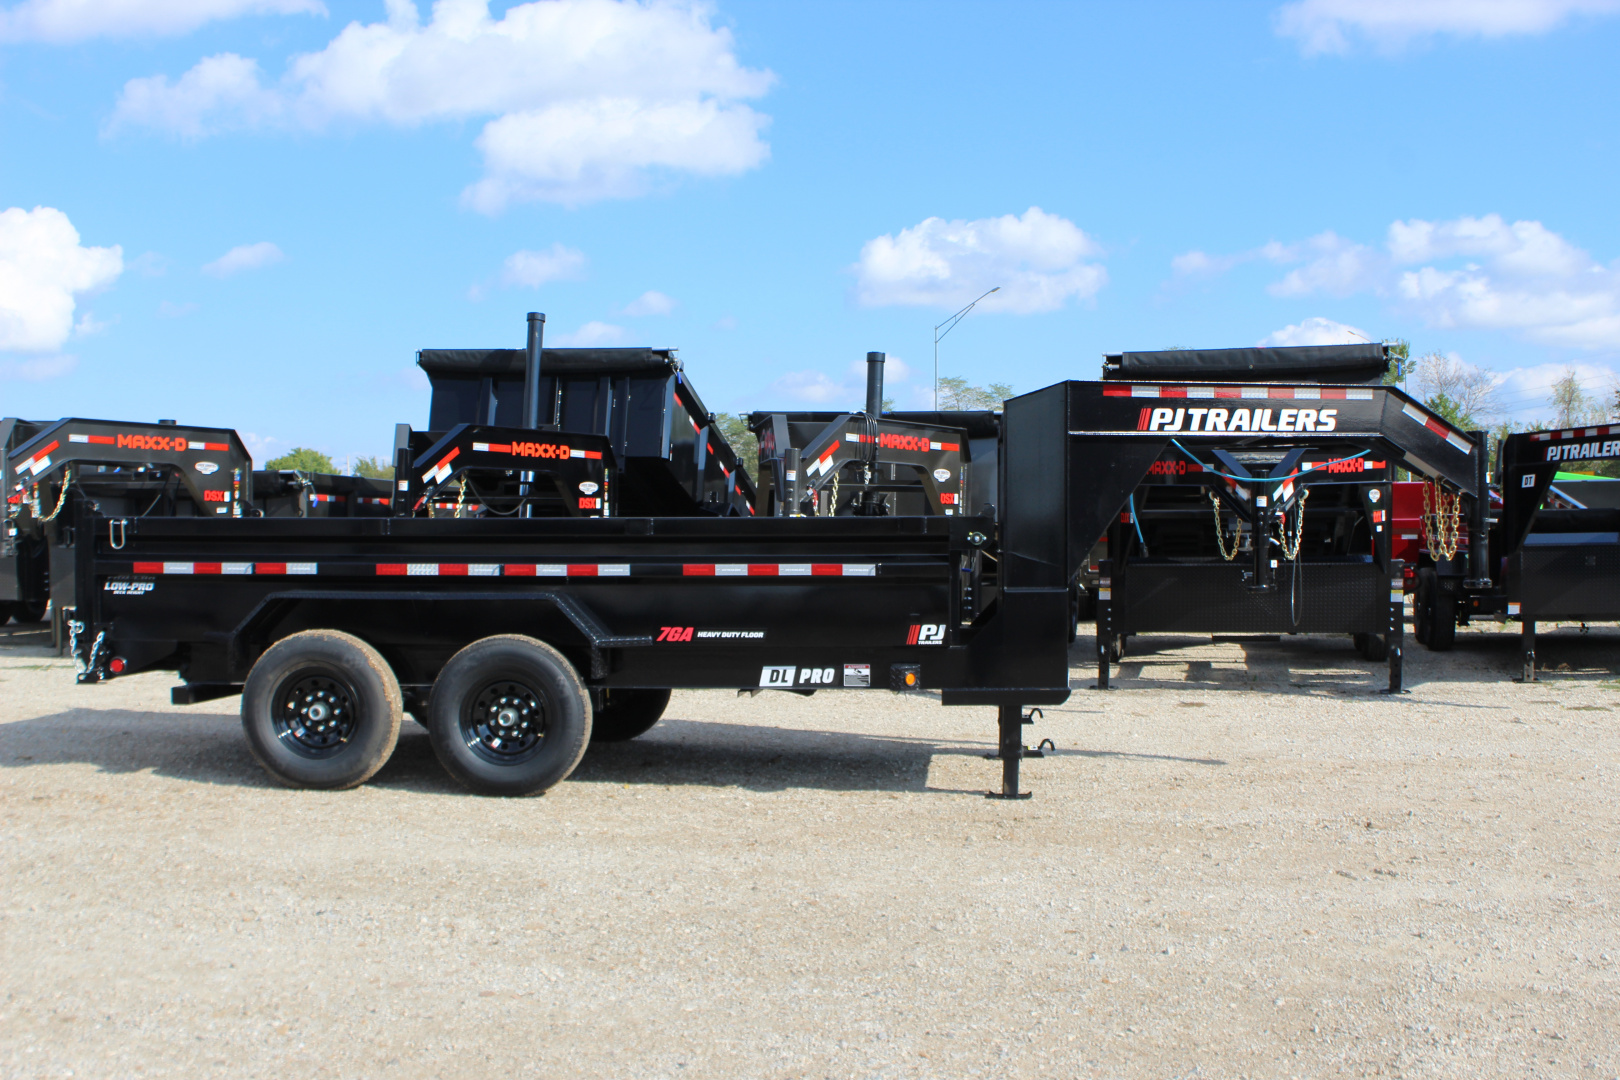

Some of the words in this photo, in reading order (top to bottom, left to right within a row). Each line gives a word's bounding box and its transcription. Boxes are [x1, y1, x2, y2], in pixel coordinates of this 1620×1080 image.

[1149, 408, 1186, 431] PJ
[1187, 408, 1338, 432] TRAILERS
[117, 434, 187, 451] MAXX-D
[512, 441, 570, 459] MAXX-D
[880, 433, 930, 452] MAXX-D
[1546, 446, 1562, 461] PJ
[1328, 457, 1364, 473] MAXX-D
[203, 490, 224, 501] DSX
[579, 497, 596, 508] DSX
[103, 581, 155, 591] LOW-PRO
[656, 626, 694, 641] 7GA
[918, 624, 946, 640] PJ
[768, 669, 789, 684] DL
[798, 668, 836, 684] PRO
